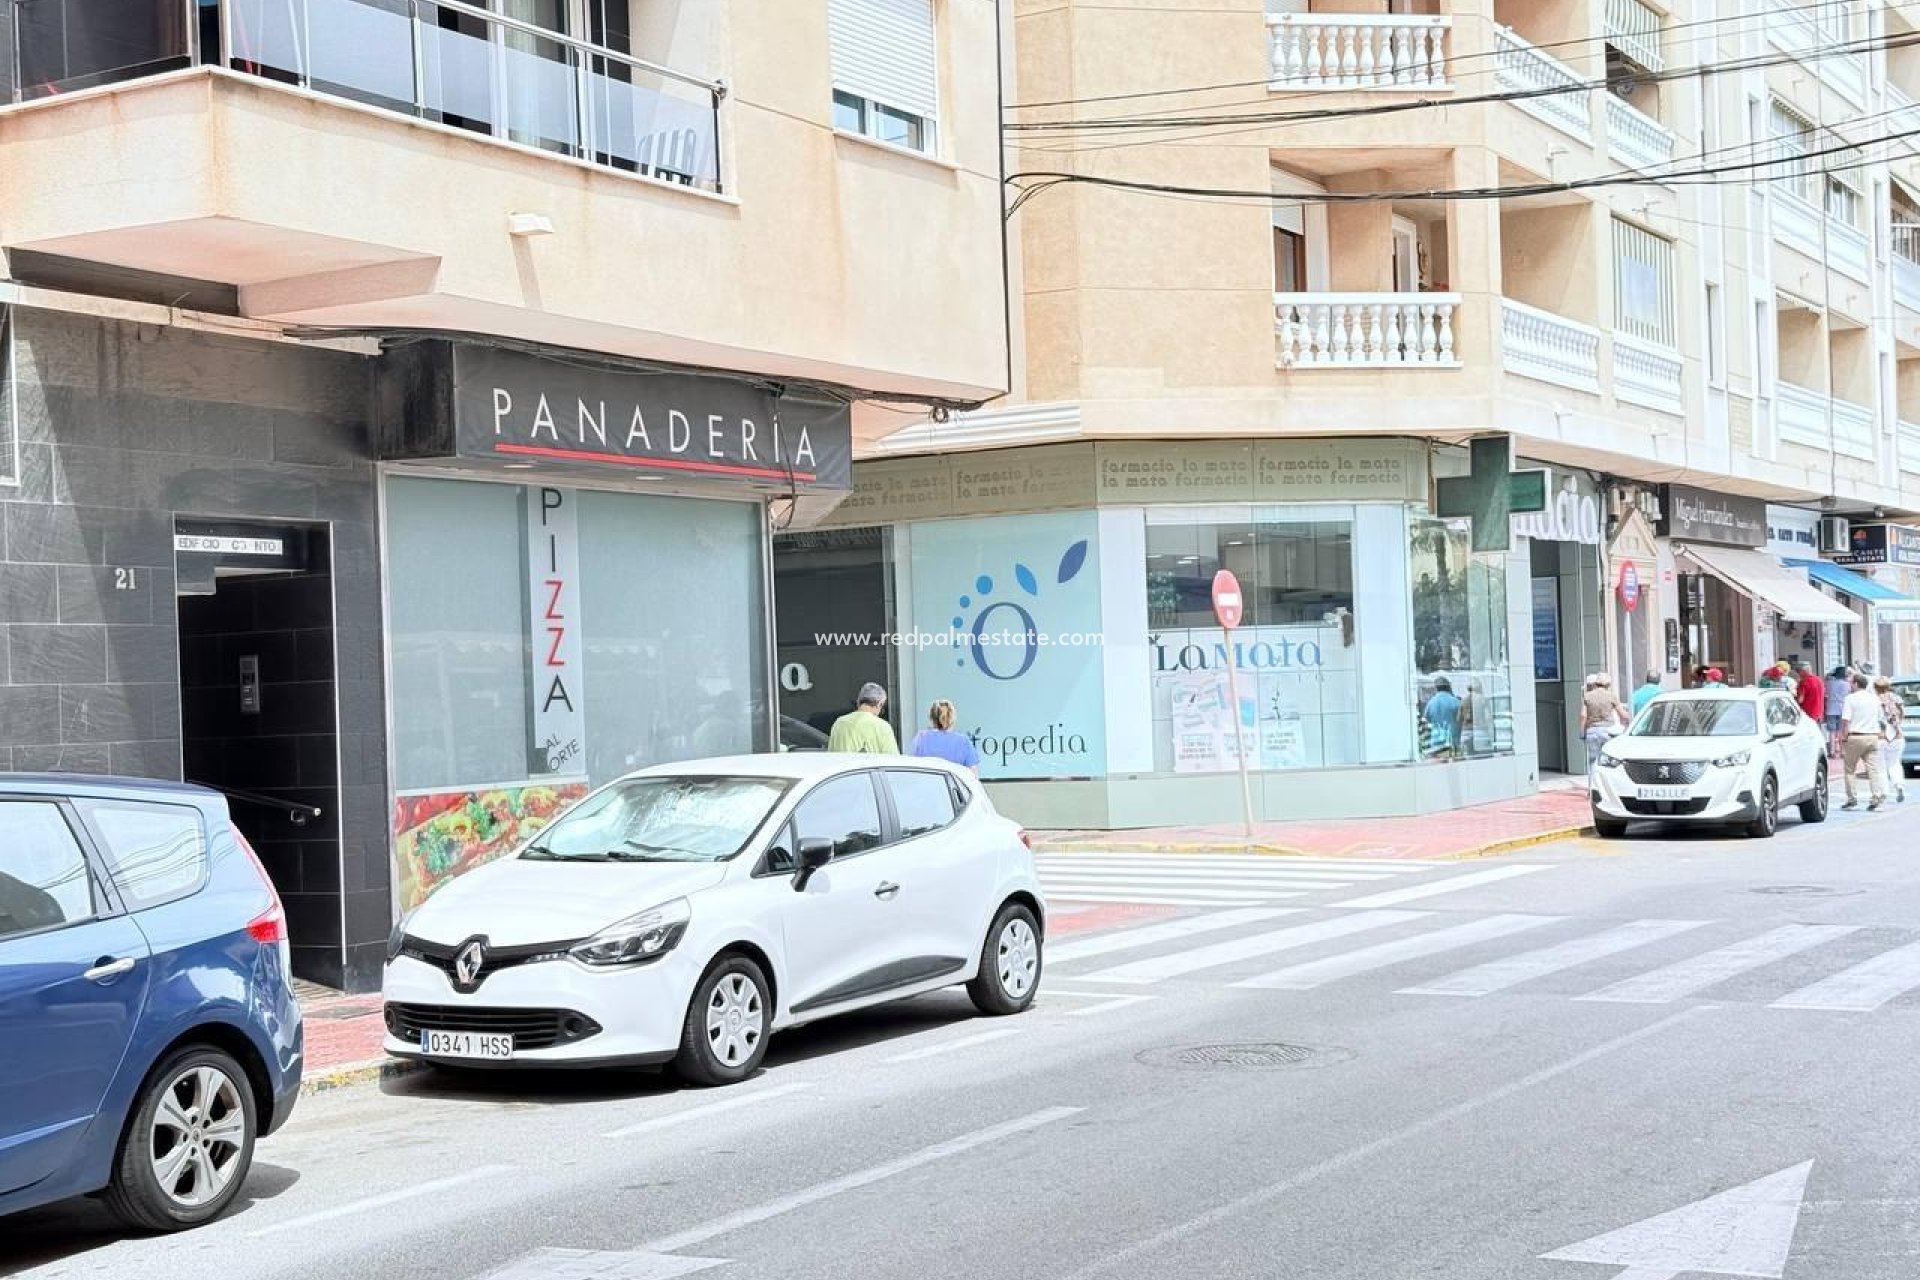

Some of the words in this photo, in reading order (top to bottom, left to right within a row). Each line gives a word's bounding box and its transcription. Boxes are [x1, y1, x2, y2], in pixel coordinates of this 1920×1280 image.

[116, 567, 137, 590] 21
[541, 486, 574, 714] PIZZA
[549, 738, 581, 771] ORTE
[431, 1034, 471, 1054] 0341
[480, 1036, 510, 1056] HSS
